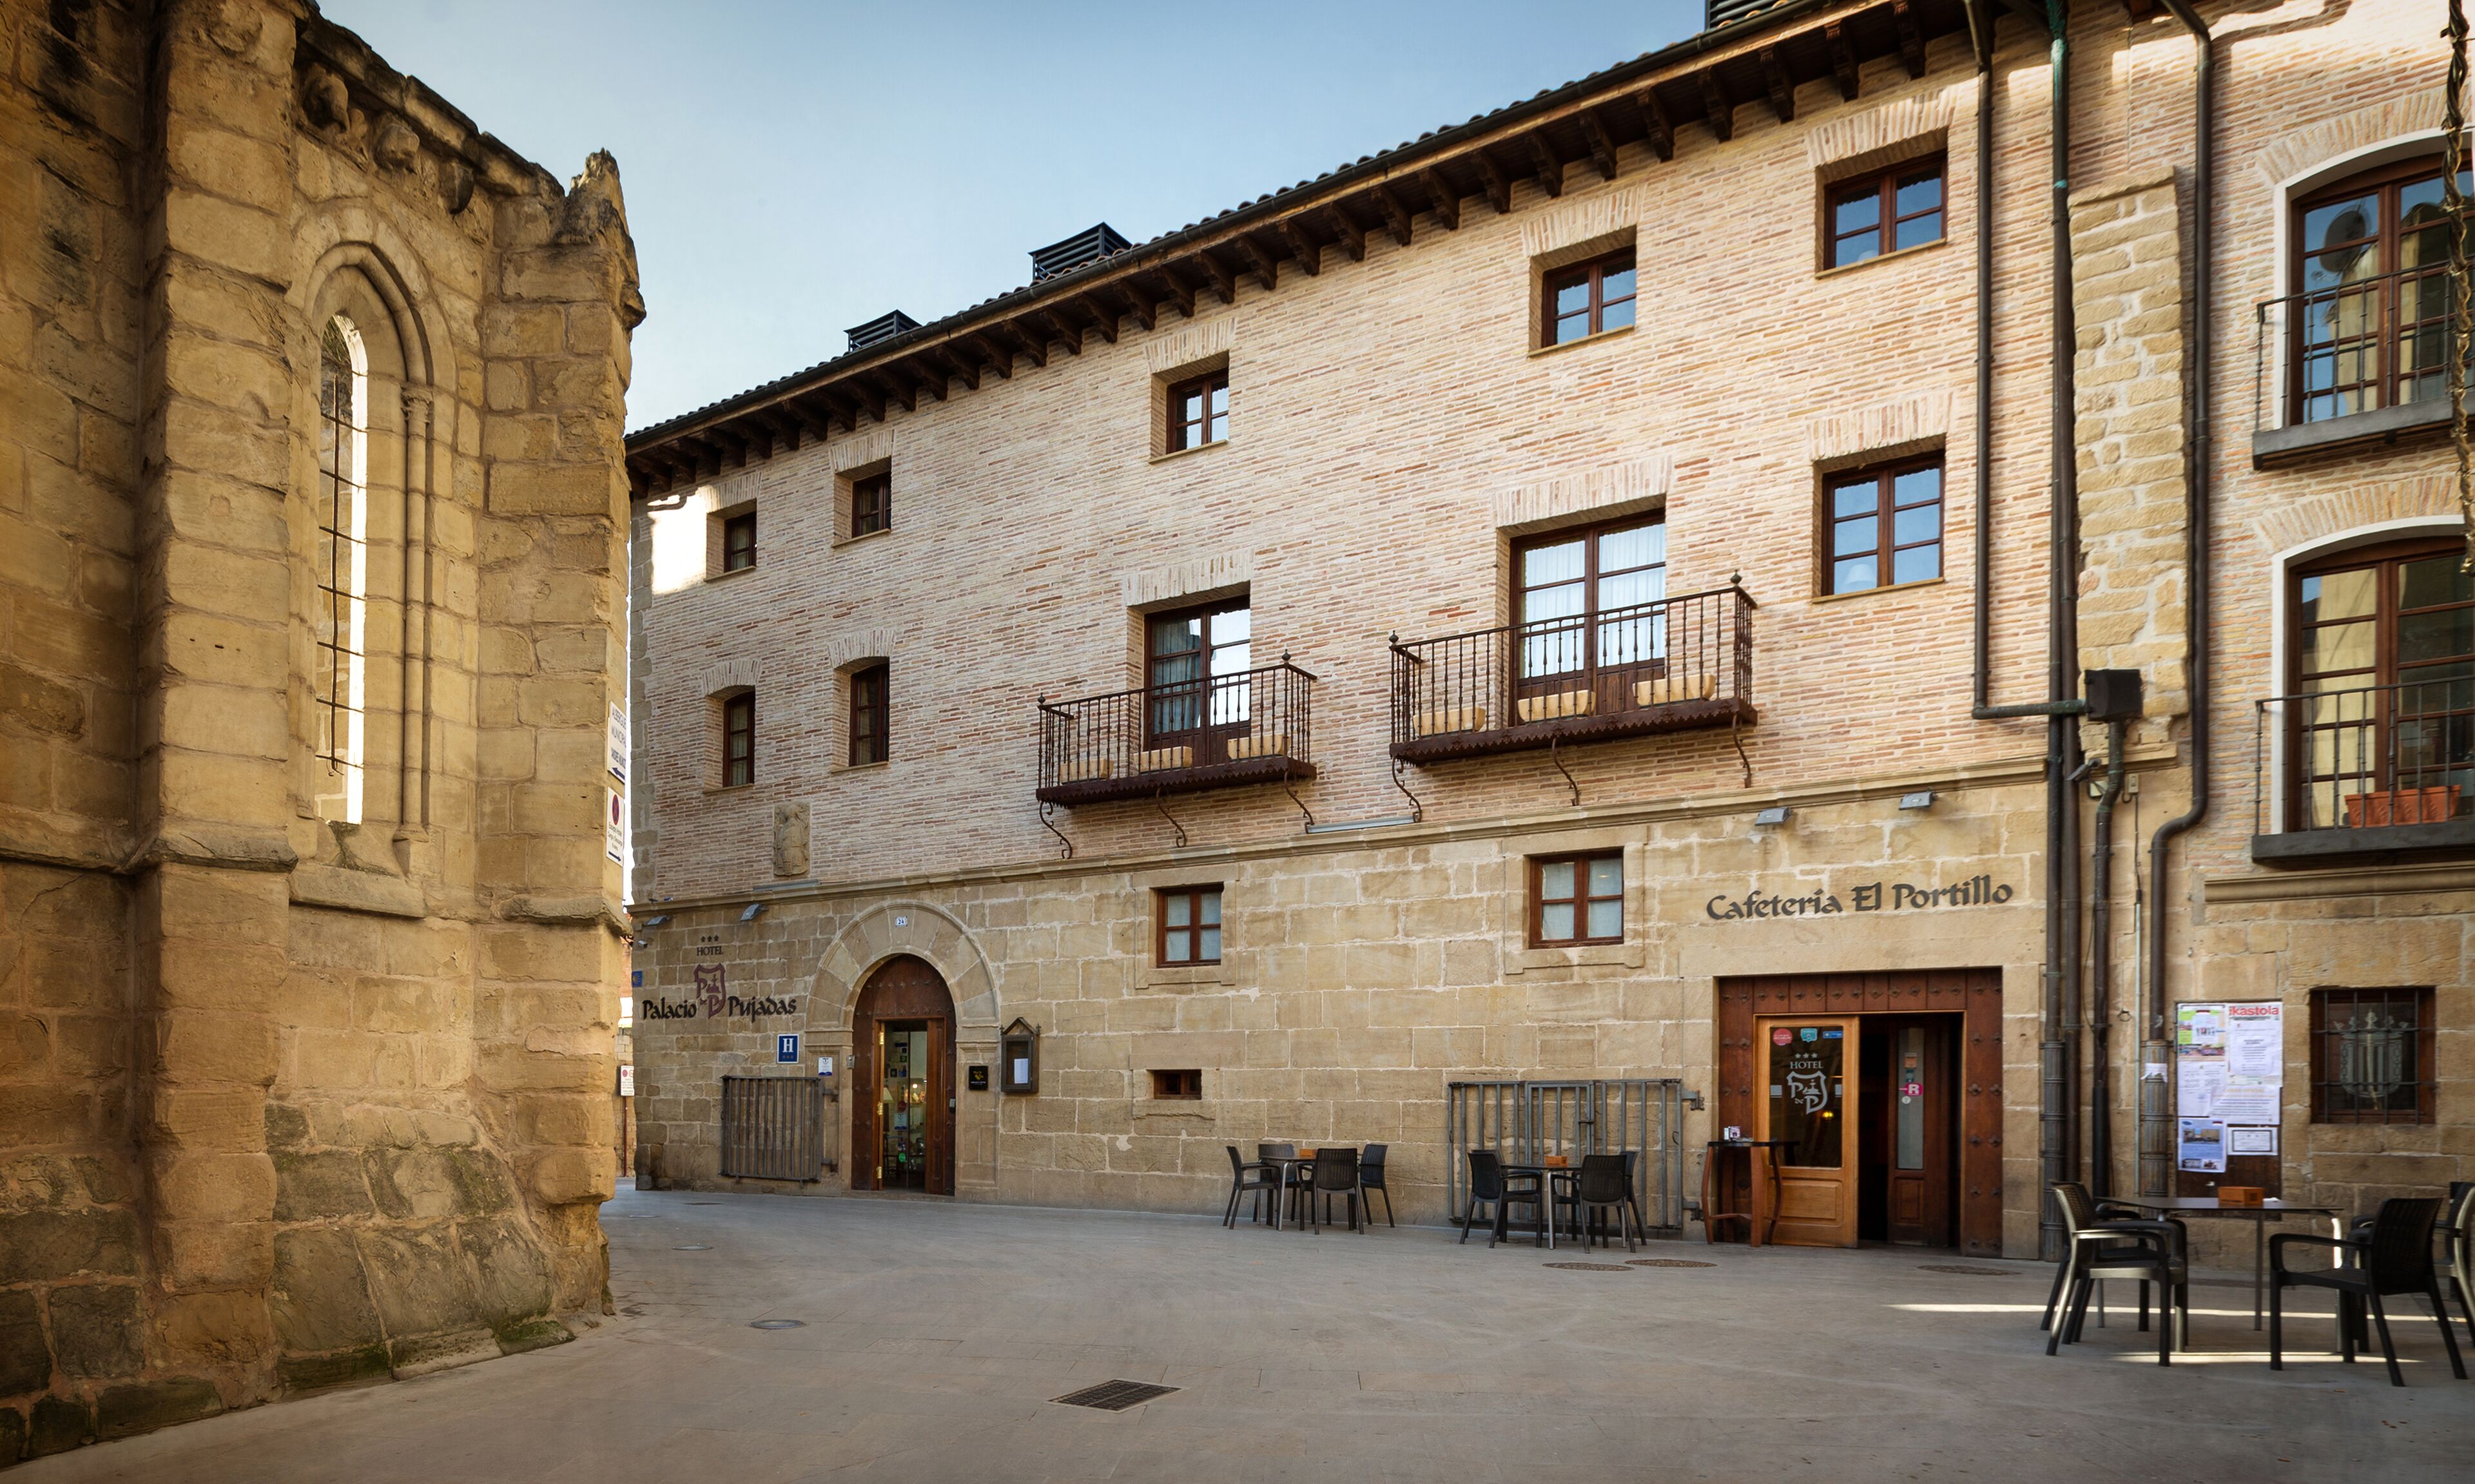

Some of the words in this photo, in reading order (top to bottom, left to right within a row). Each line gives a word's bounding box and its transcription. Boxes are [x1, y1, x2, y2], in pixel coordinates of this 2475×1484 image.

[1706, 888, 1843, 920] Cafetería
[1851, 882, 1881, 912] El
[1892, 874, 2014, 911] Portillo
[697, 945, 724, 957] HOTEL
[642, 996, 697, 1021] Palacio
[727, 995, 797, 1024] Pujadas
[782, 1037, 794, 1053] H
[1790, 1061, 1824, 1069] HOTEL
[1908, 1084, 1919, 1094] R
